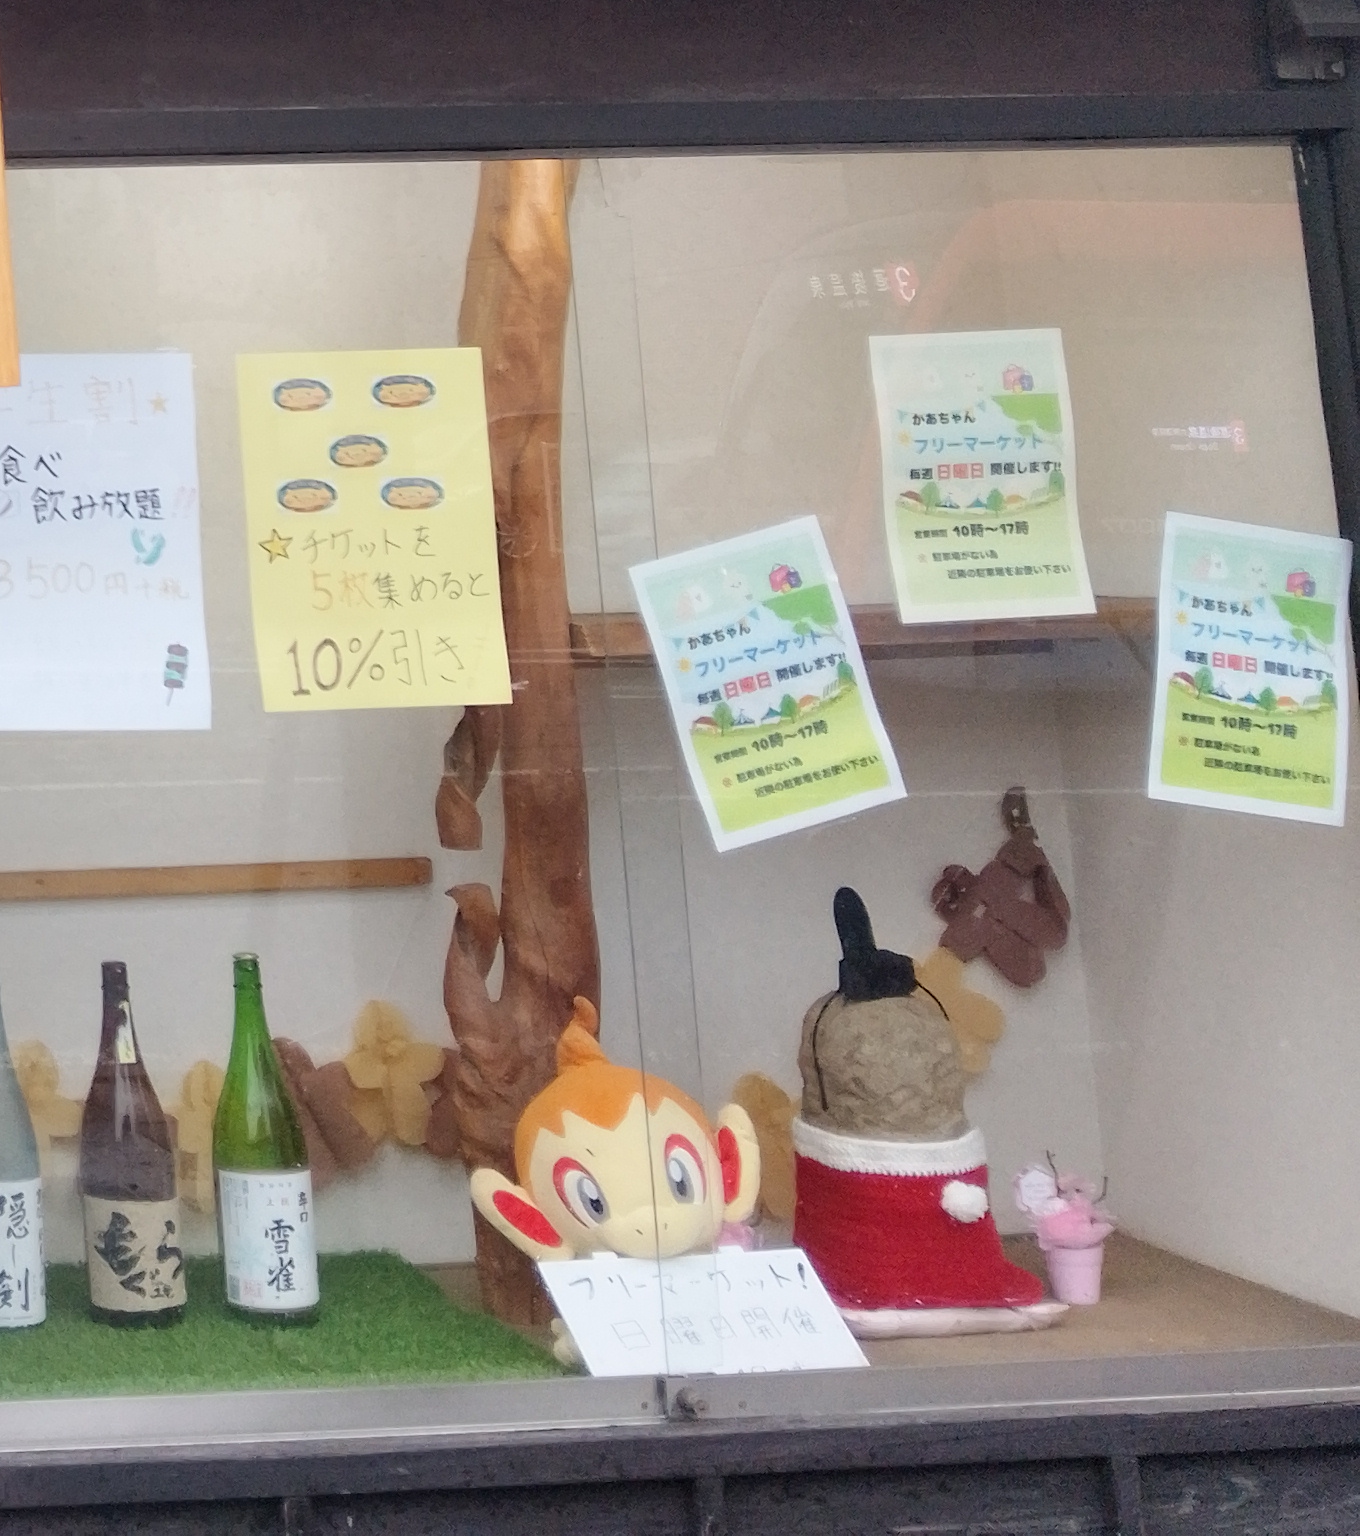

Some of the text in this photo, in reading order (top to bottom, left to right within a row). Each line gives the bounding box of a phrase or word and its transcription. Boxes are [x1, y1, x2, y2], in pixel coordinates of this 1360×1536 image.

[912, 411, 976, 426] かあちゃん
[914, 433, 1043, 454] フリーマーケット
[310, 568, 492, 612] 5枚集めると
[1191, 595, 1254, 618] かあちゃん
[687, 623, 752, 651] かあちゃん
[695, 629, 823, 677] フリーマーケット
[1191, 621, 1317, 655] フリーマーケット
[264, 1218, 297, 1293] 雪雀
[568, 1261, 809, 1301] フリーマーケット!
[610, 1305, 822, 1352] 日曜日開催
